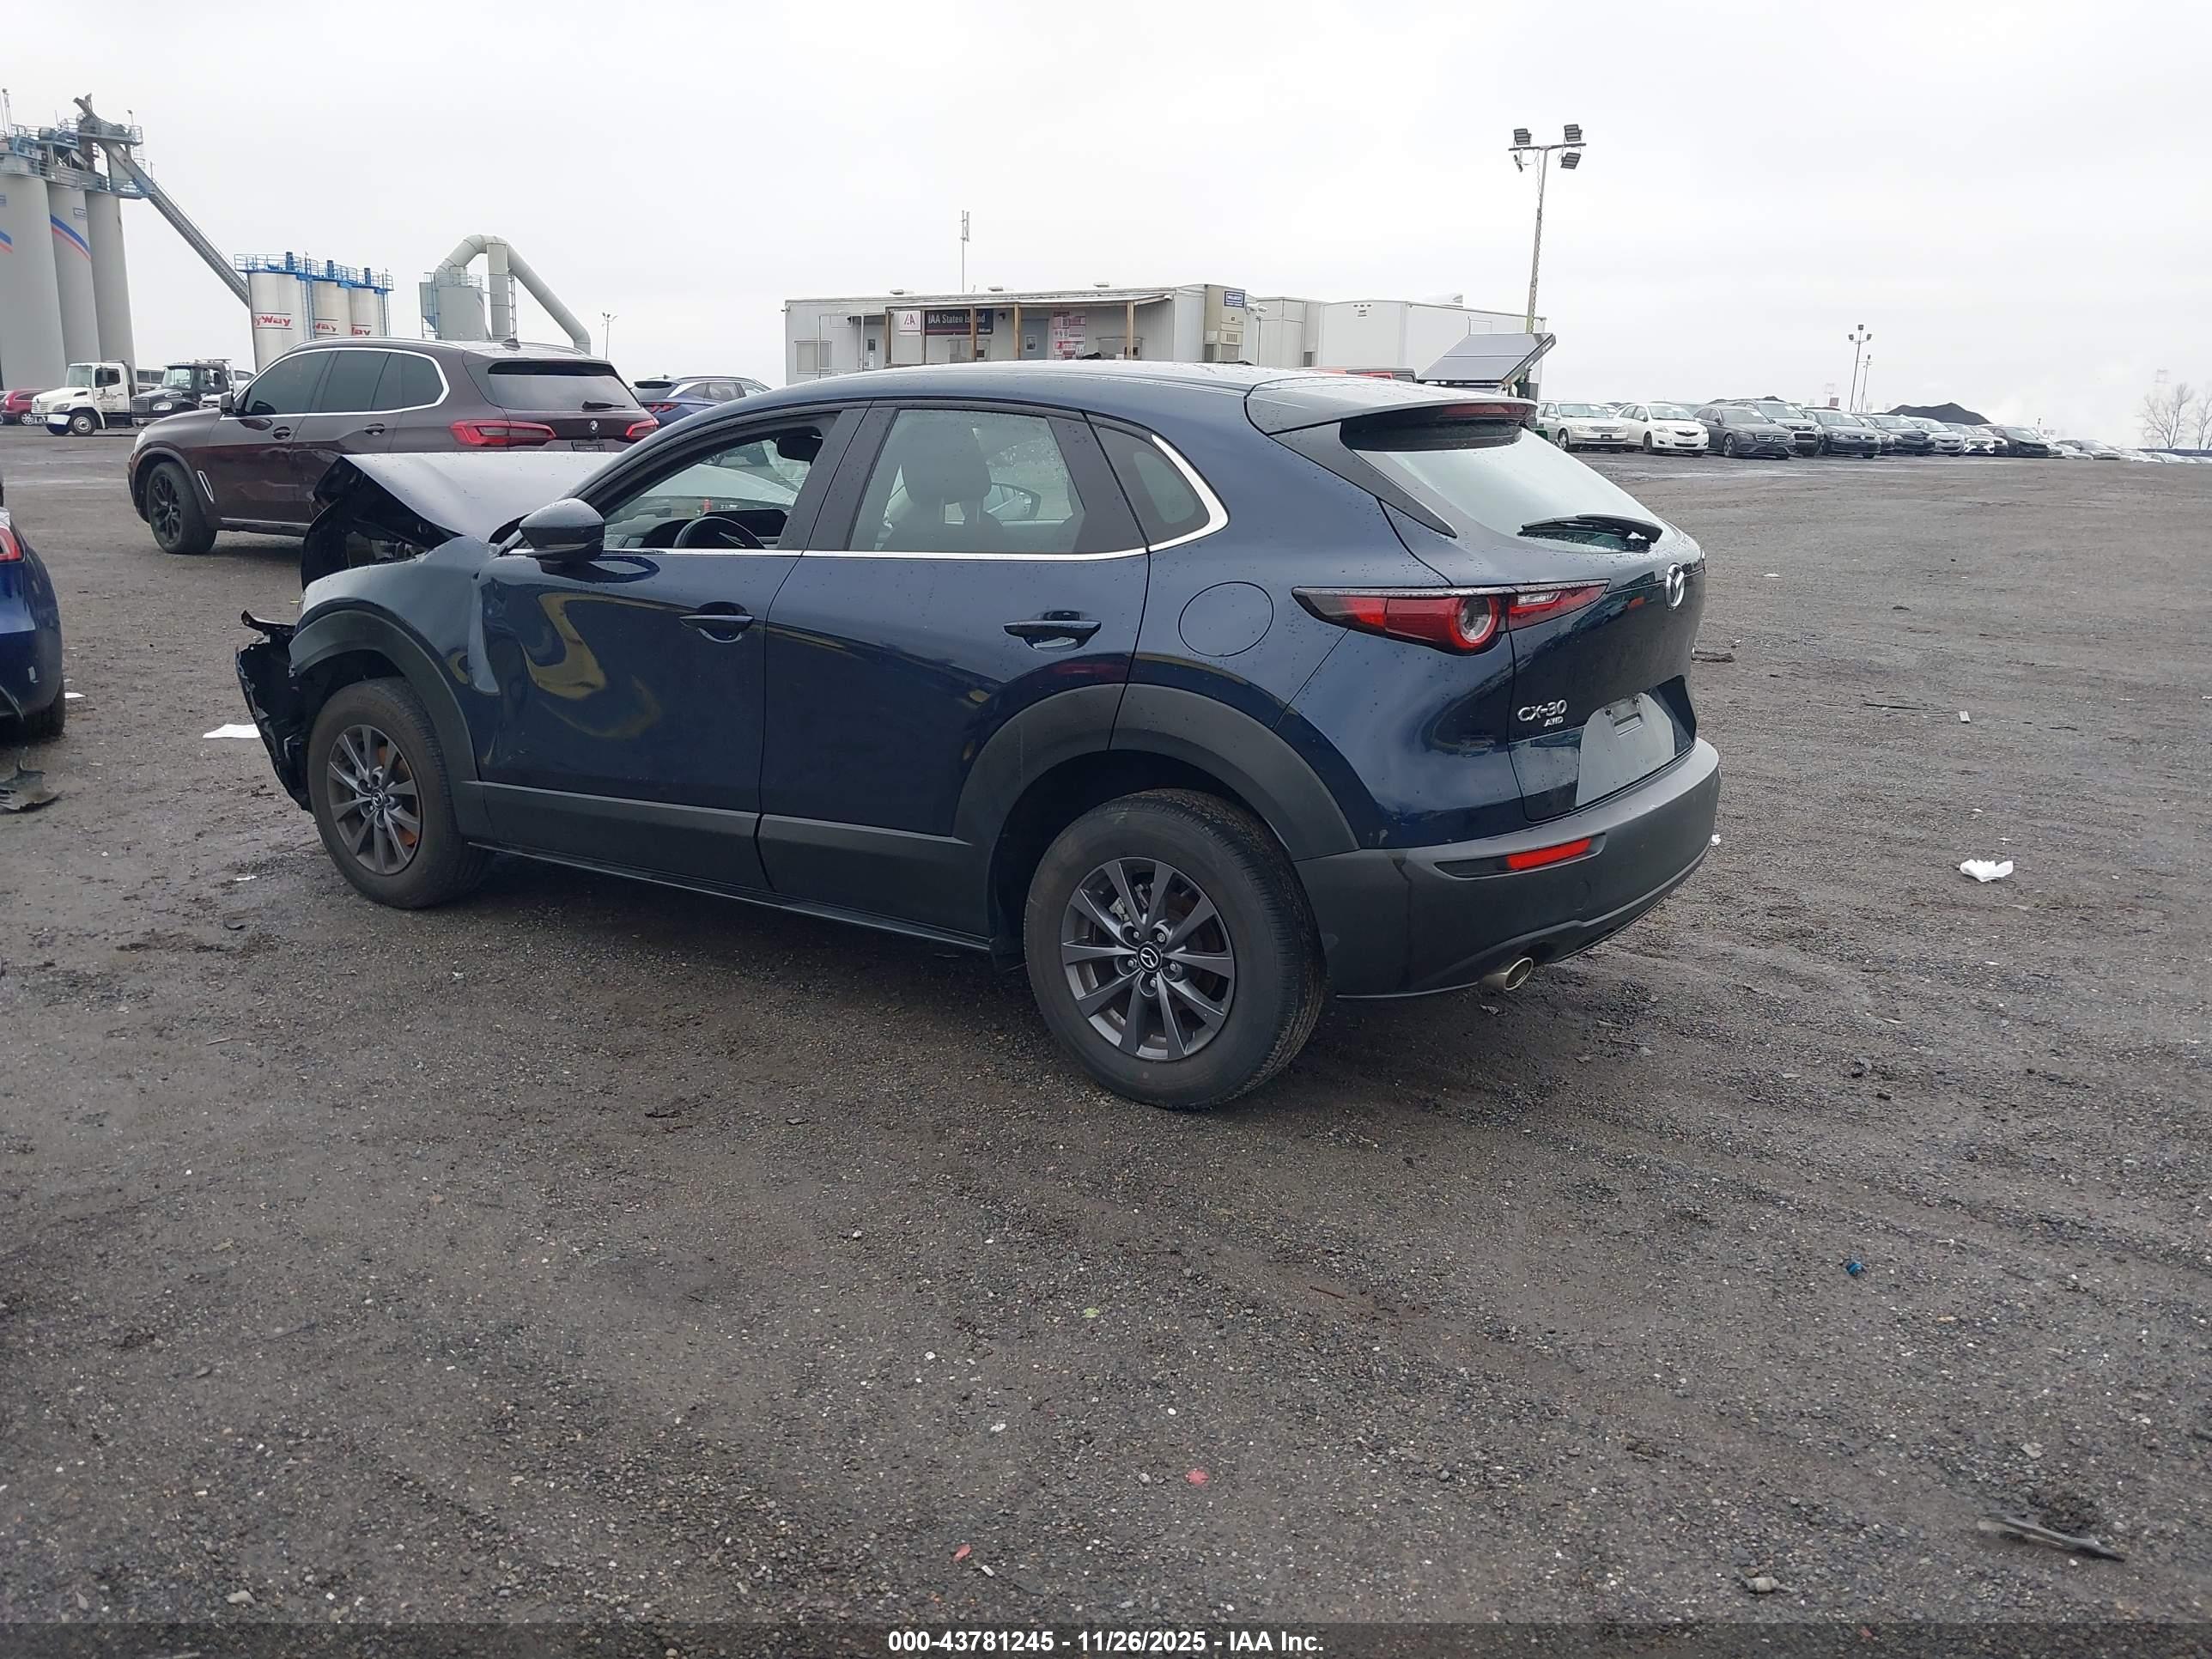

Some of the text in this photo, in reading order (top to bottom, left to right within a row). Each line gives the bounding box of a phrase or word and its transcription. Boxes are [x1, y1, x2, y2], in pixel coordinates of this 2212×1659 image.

[927, 313, 986, 325] IAA Staten Isnd
[1518, 700, 1567, 721] CX-30
